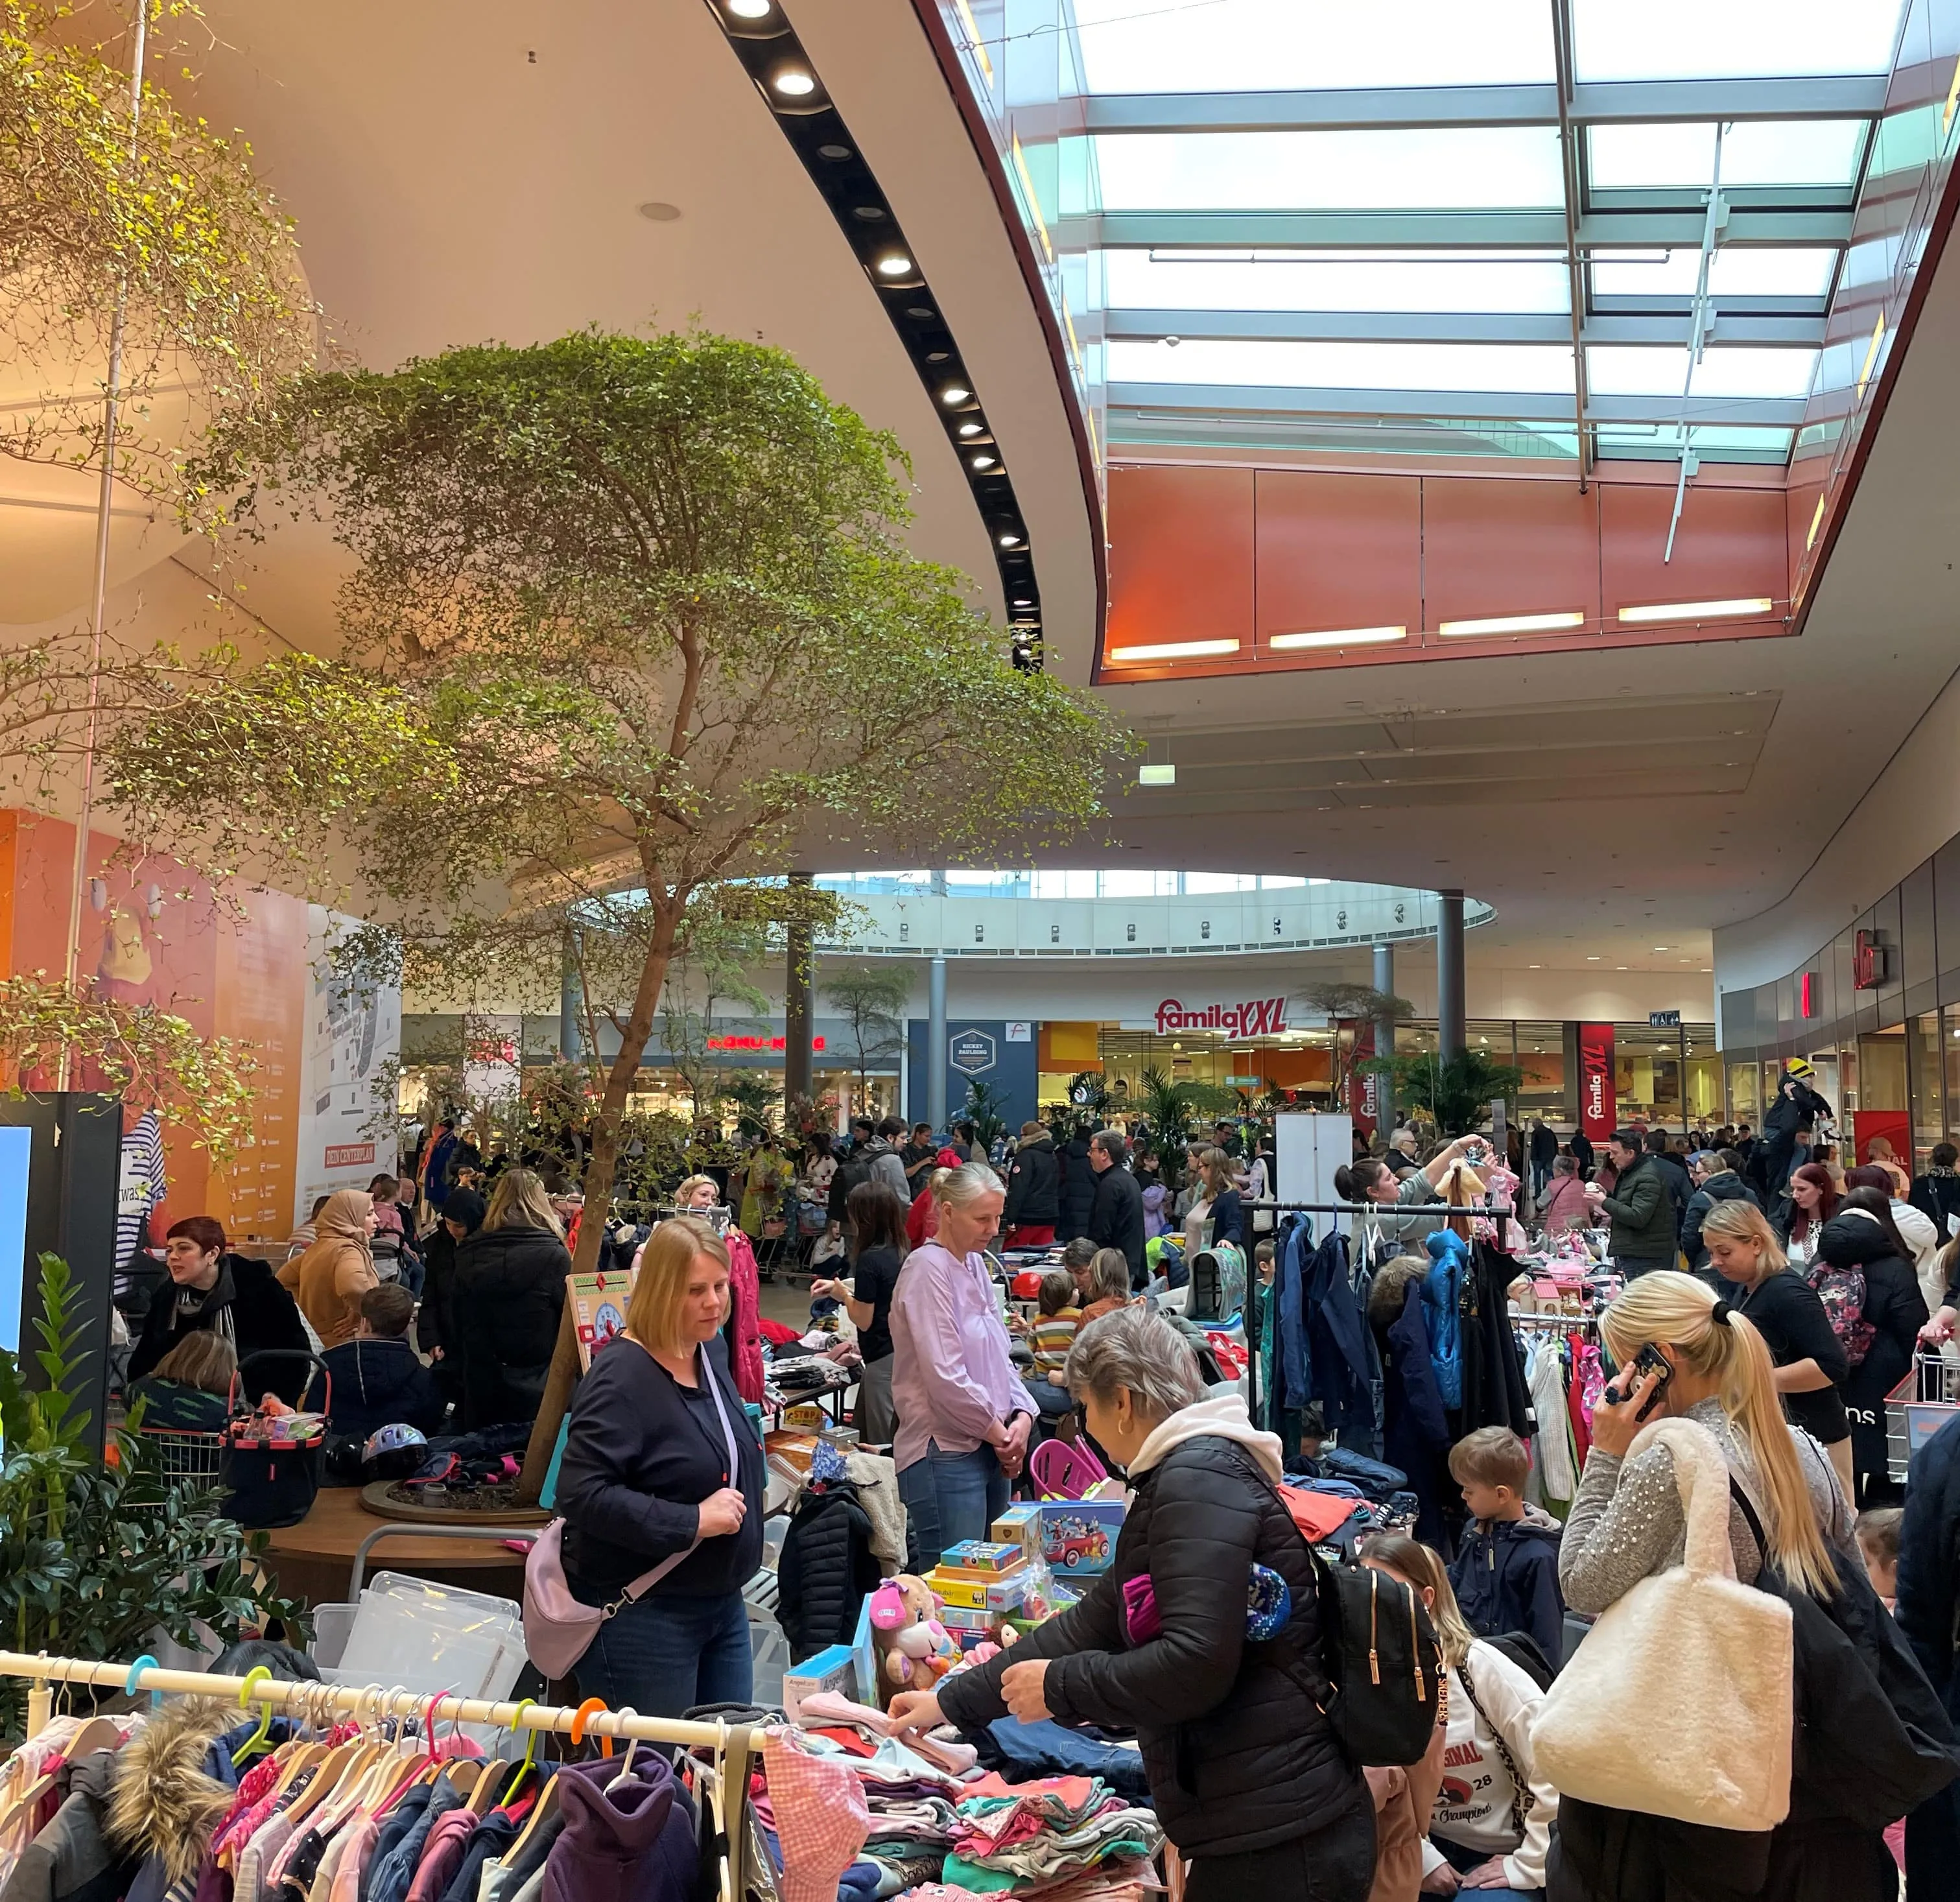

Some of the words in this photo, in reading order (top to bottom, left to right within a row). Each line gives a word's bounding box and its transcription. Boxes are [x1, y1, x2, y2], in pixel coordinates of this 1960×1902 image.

[1155, 999, 1238, 1033] famila
[707, 1036, 825, 1051] NANU-NA
[1587, 1075, 1605, 1120] famila
[327, 1149, 340, 1164] DEIN
[340, 1147, 373, 1163] CENTERPLAN
[794, 1410, 816, 1420] STOP
[1472, 1774, 1493, 1790] 28
[1439, 1803, 1492, 1824] Champions
